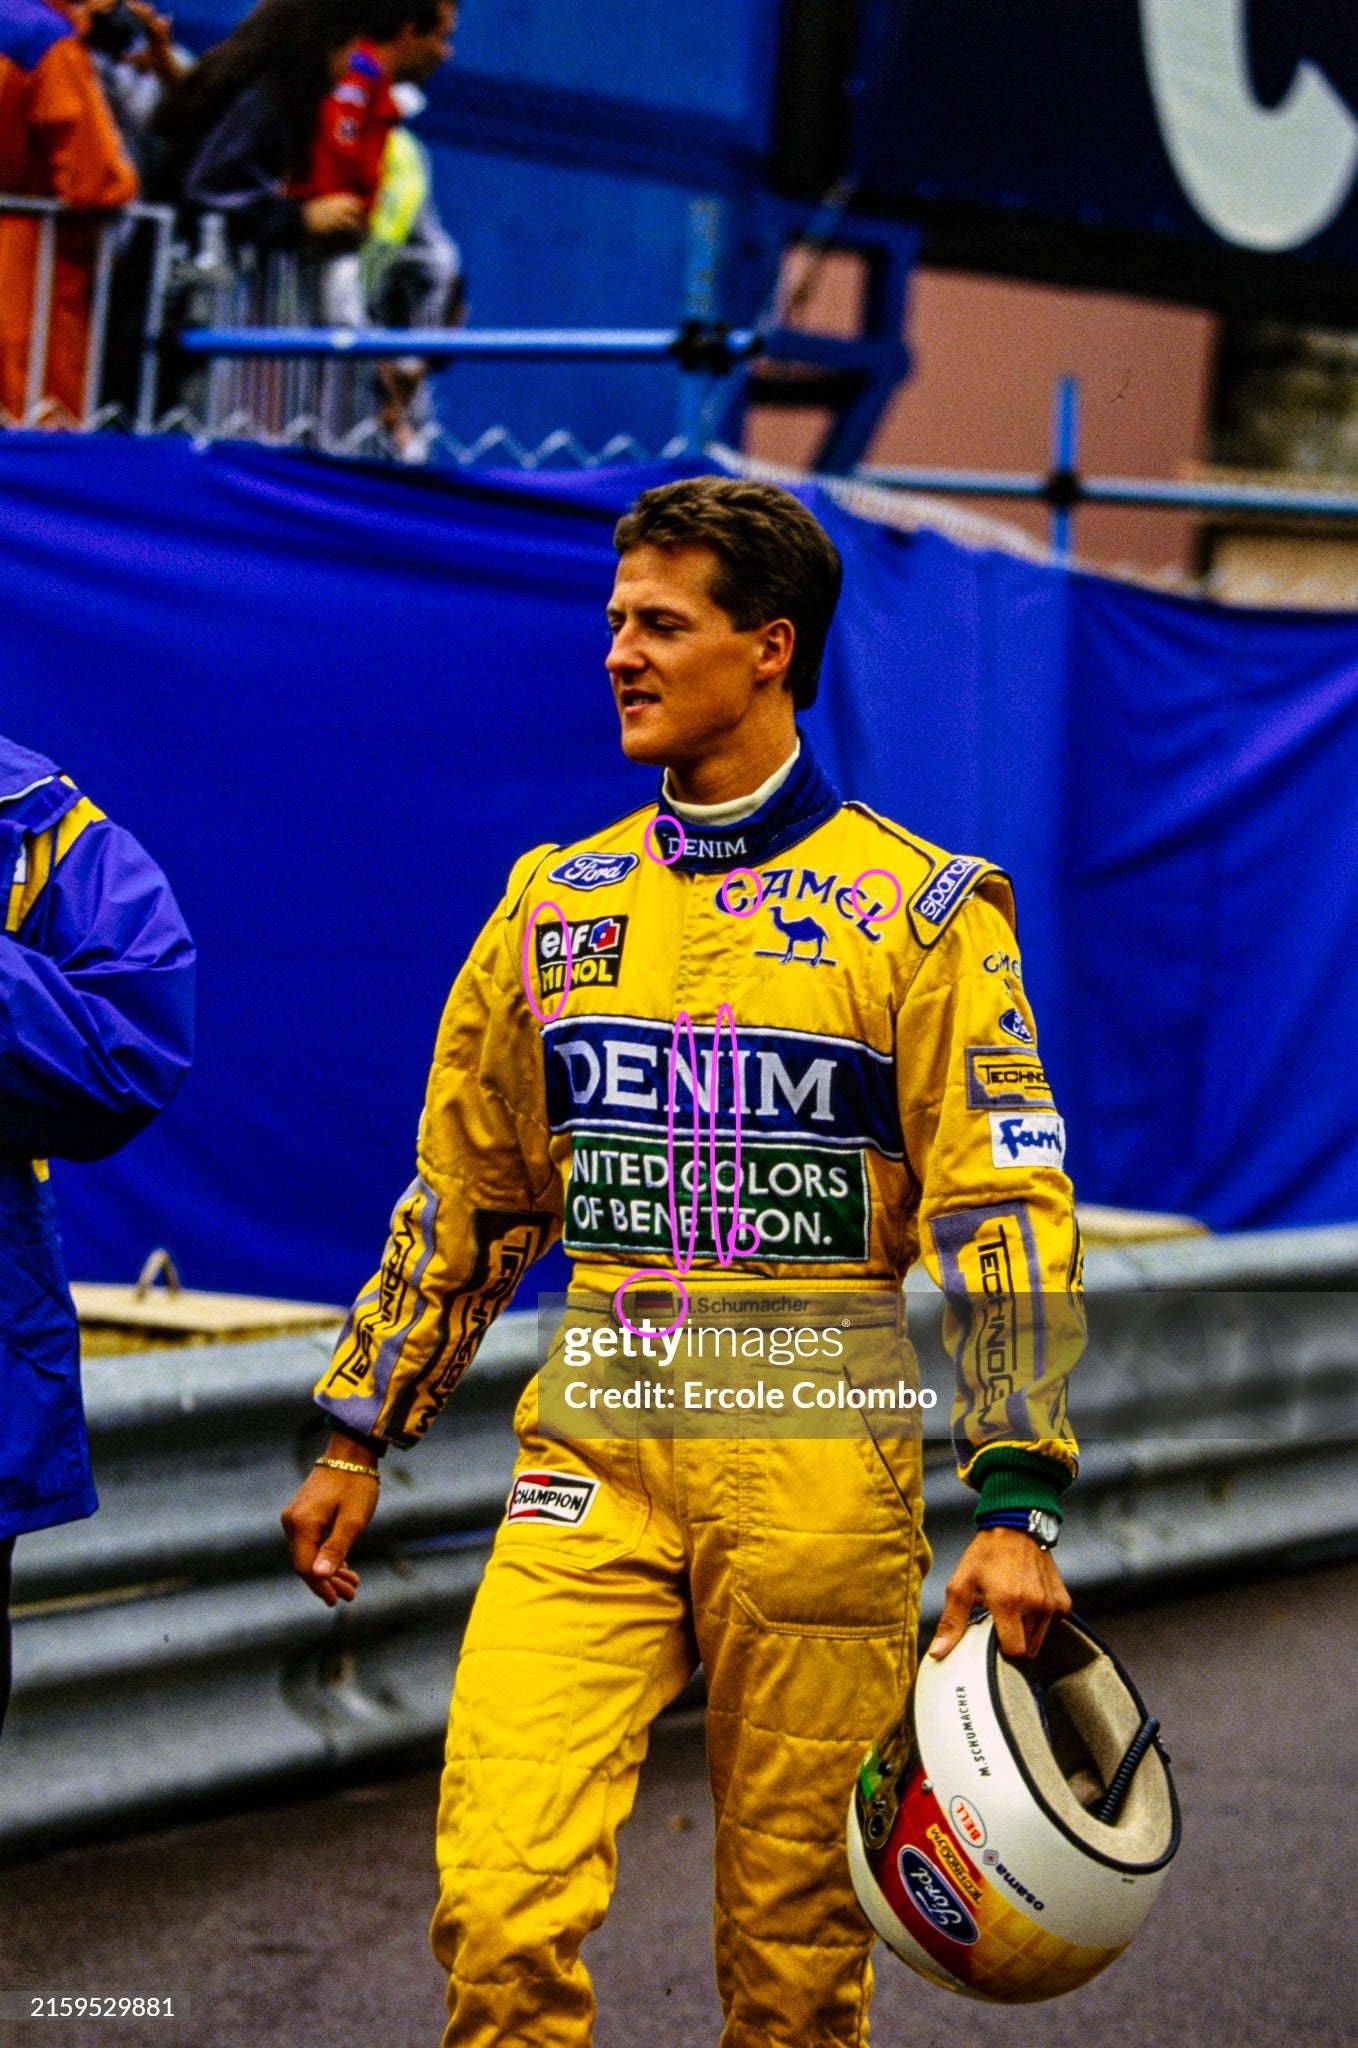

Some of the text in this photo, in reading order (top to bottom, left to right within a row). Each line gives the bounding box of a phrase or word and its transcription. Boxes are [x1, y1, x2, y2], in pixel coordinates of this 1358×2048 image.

[667, 835, 747, 859] DENIM
[564, 856, 623, 882] Ford
[715, 868, 884, 942] CAMEL
[920, 857, 973, 921] sparco
[541, 924, 589, 959] elf
[541, 958, 613, 992] MINOL
[553, 1039, 838, 1122] DENIM
[679, 1158, 849, 1198] COLORS
[572, 1195, 833, 1246] OF BENETTON.
[677, 1295, 811, 1314] M.Schumacher
[514, 1488, 583, 1511] CHAMPION
[956, 1802, 982, 1841] BELL
[910, 1867, 962, 1925] Ford
[996, 1863, 1045, 1911] osama
